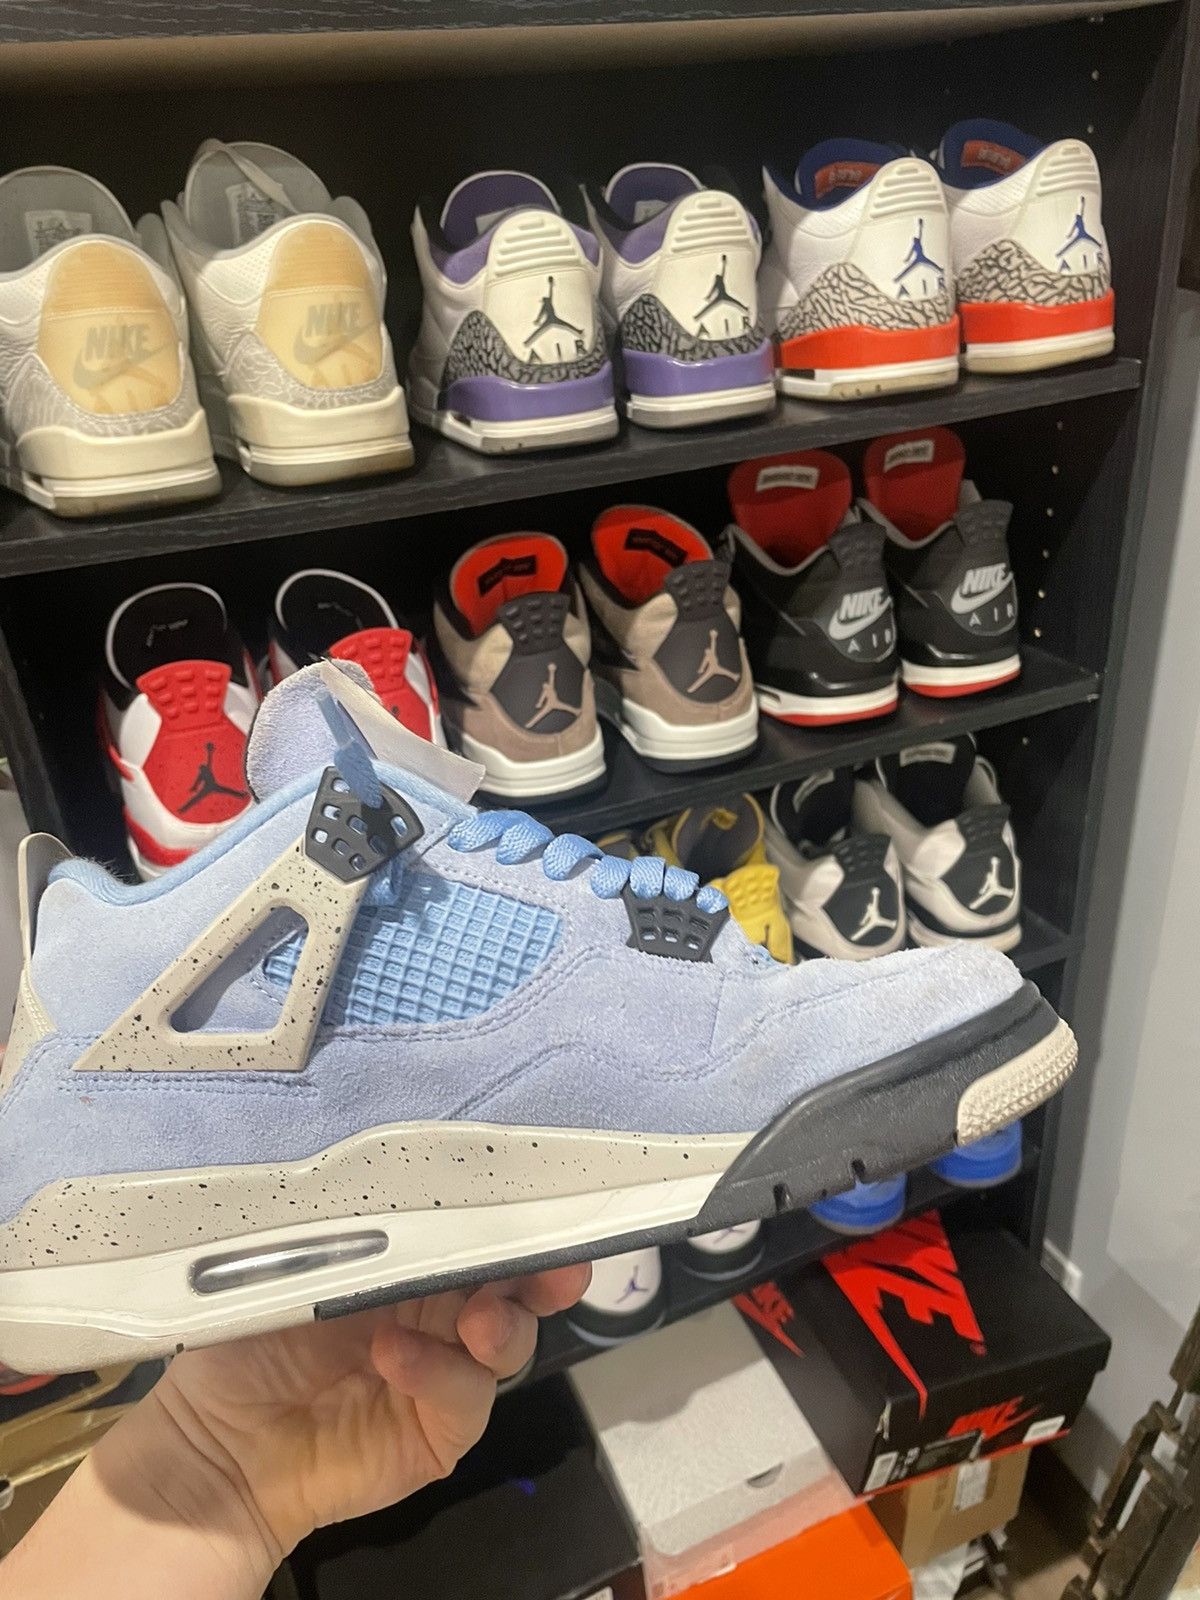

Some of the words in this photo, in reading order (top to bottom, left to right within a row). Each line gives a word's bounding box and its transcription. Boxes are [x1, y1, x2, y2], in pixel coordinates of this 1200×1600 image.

[1058, 252, 1106, 272] AIR
[897, 277, 946, 299] AIR
[304, 301, 363, 338] NIKE
[697, 316, 753, 338] AIR
[84, 323, 152, 361] NIKE
[529, 339, 588, 363] AIR
[962, 562, 1006, 595] NIKE
[840, 587, 884, 620] NIKE
[969, 602, 1015, 627] AIR
[847, 629, 892, 653] AIR
